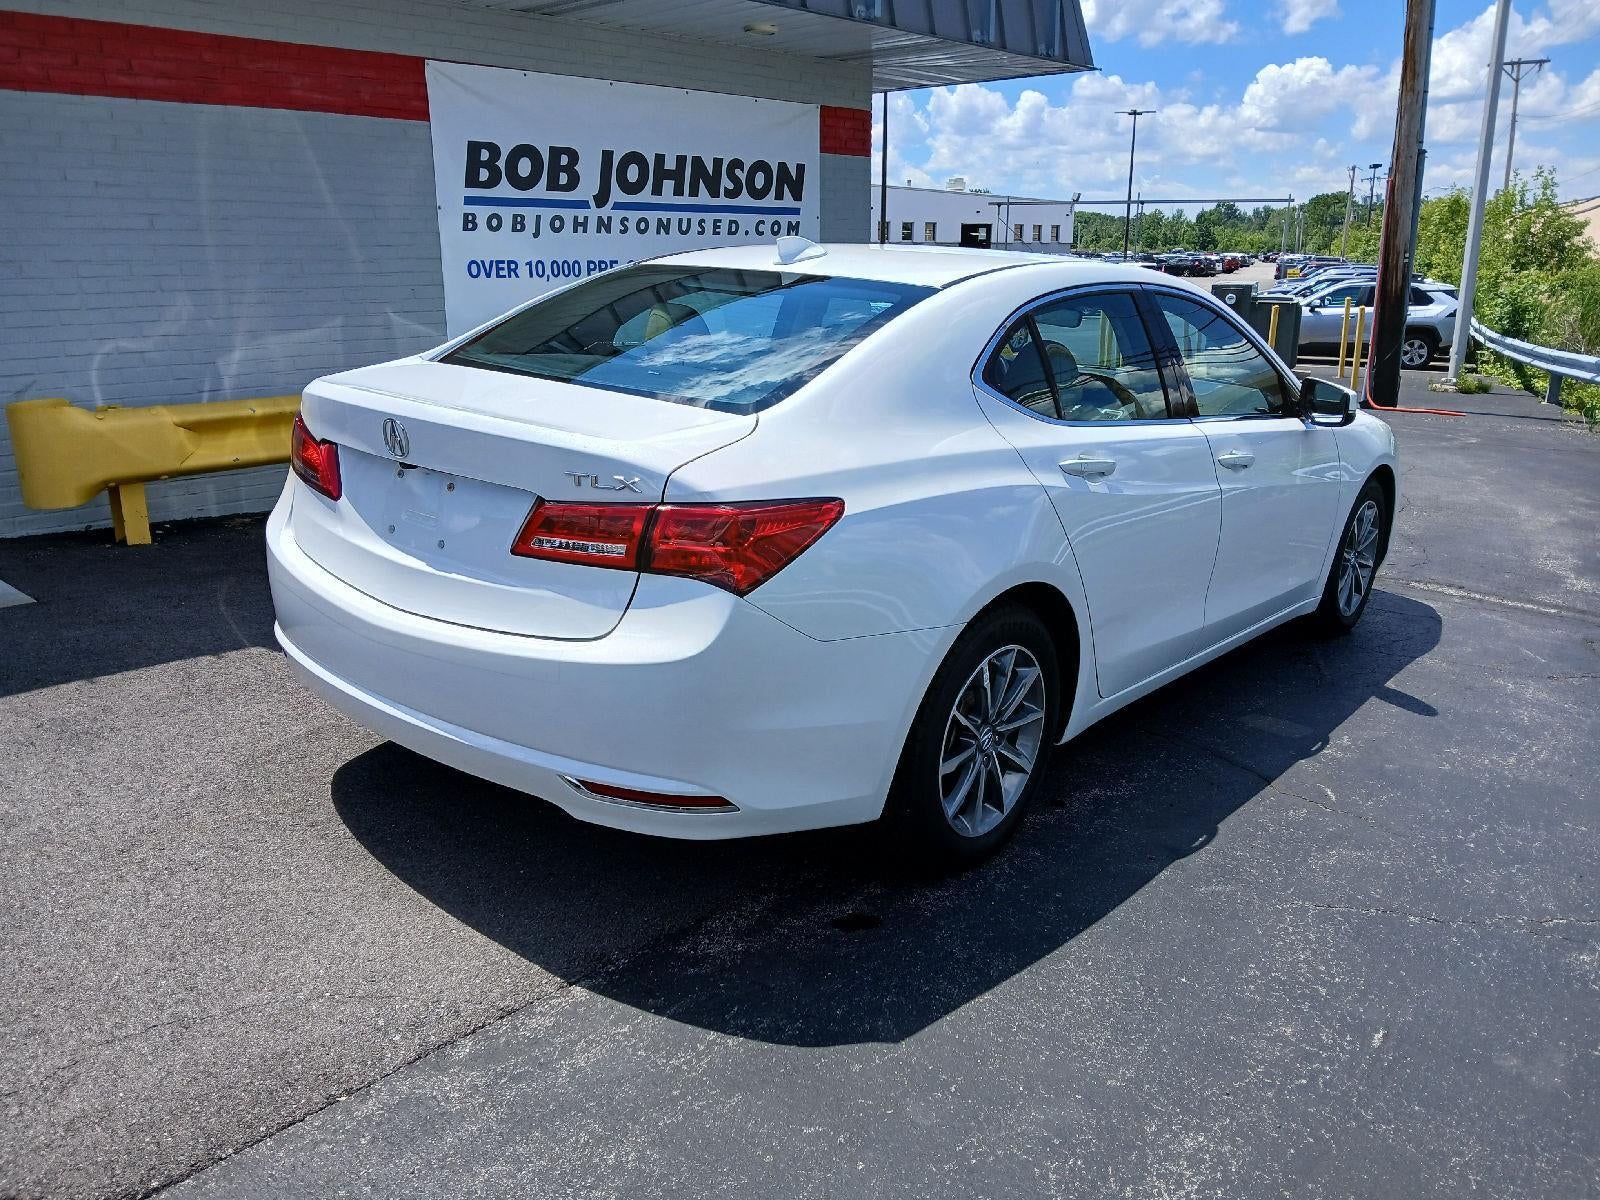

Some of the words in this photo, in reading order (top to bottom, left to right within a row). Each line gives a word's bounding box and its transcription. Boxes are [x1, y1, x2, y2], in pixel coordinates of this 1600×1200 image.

[465, 141, 581, 192] BOB
[592, 149, 806, 209] JOHNSON
[463, 212, 801, 238] BOBJOHNSONUSED.COM
[467, 259, 520, 279] OVER
[525, 259, 582, 282] 10,000
[564, 471, 643, 493] TLX
